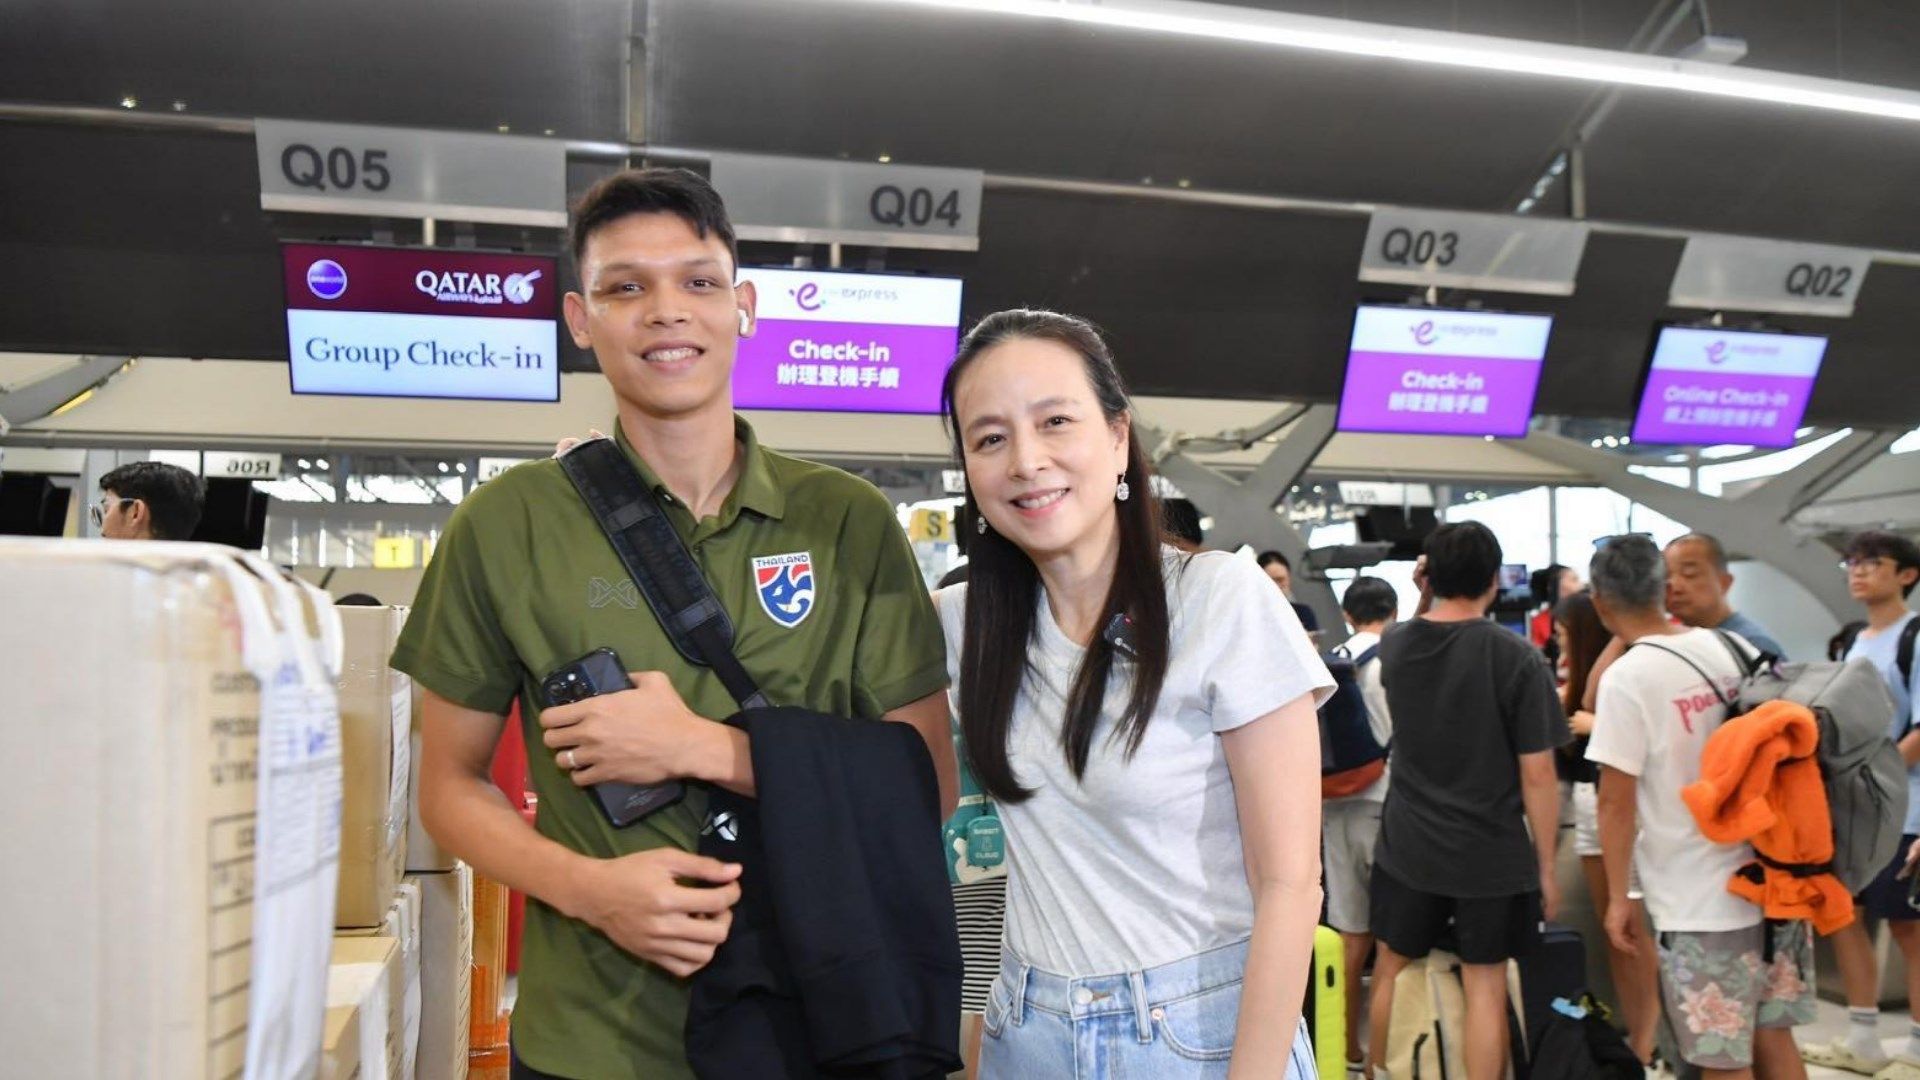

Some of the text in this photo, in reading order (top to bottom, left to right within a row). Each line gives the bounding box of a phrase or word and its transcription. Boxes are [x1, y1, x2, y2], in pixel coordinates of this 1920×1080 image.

[281, 144, 391, 192] Q05
[870, 185, 962, 228] Q04
[1381, 227, 1459, 267] Q03
[415, 270, 501, 297] QATAR
[1785, 263, 1853, 297] Q02
[841, 287, 899, 302] express
[305, 336, 543, 371] Group Check-in
[788, 339, 890, 362] Check-in
[1401, 370, 1485, 391] Check-in
[927, 511, 942, 537] S
[756, 554, 809, 567] THAILAND
